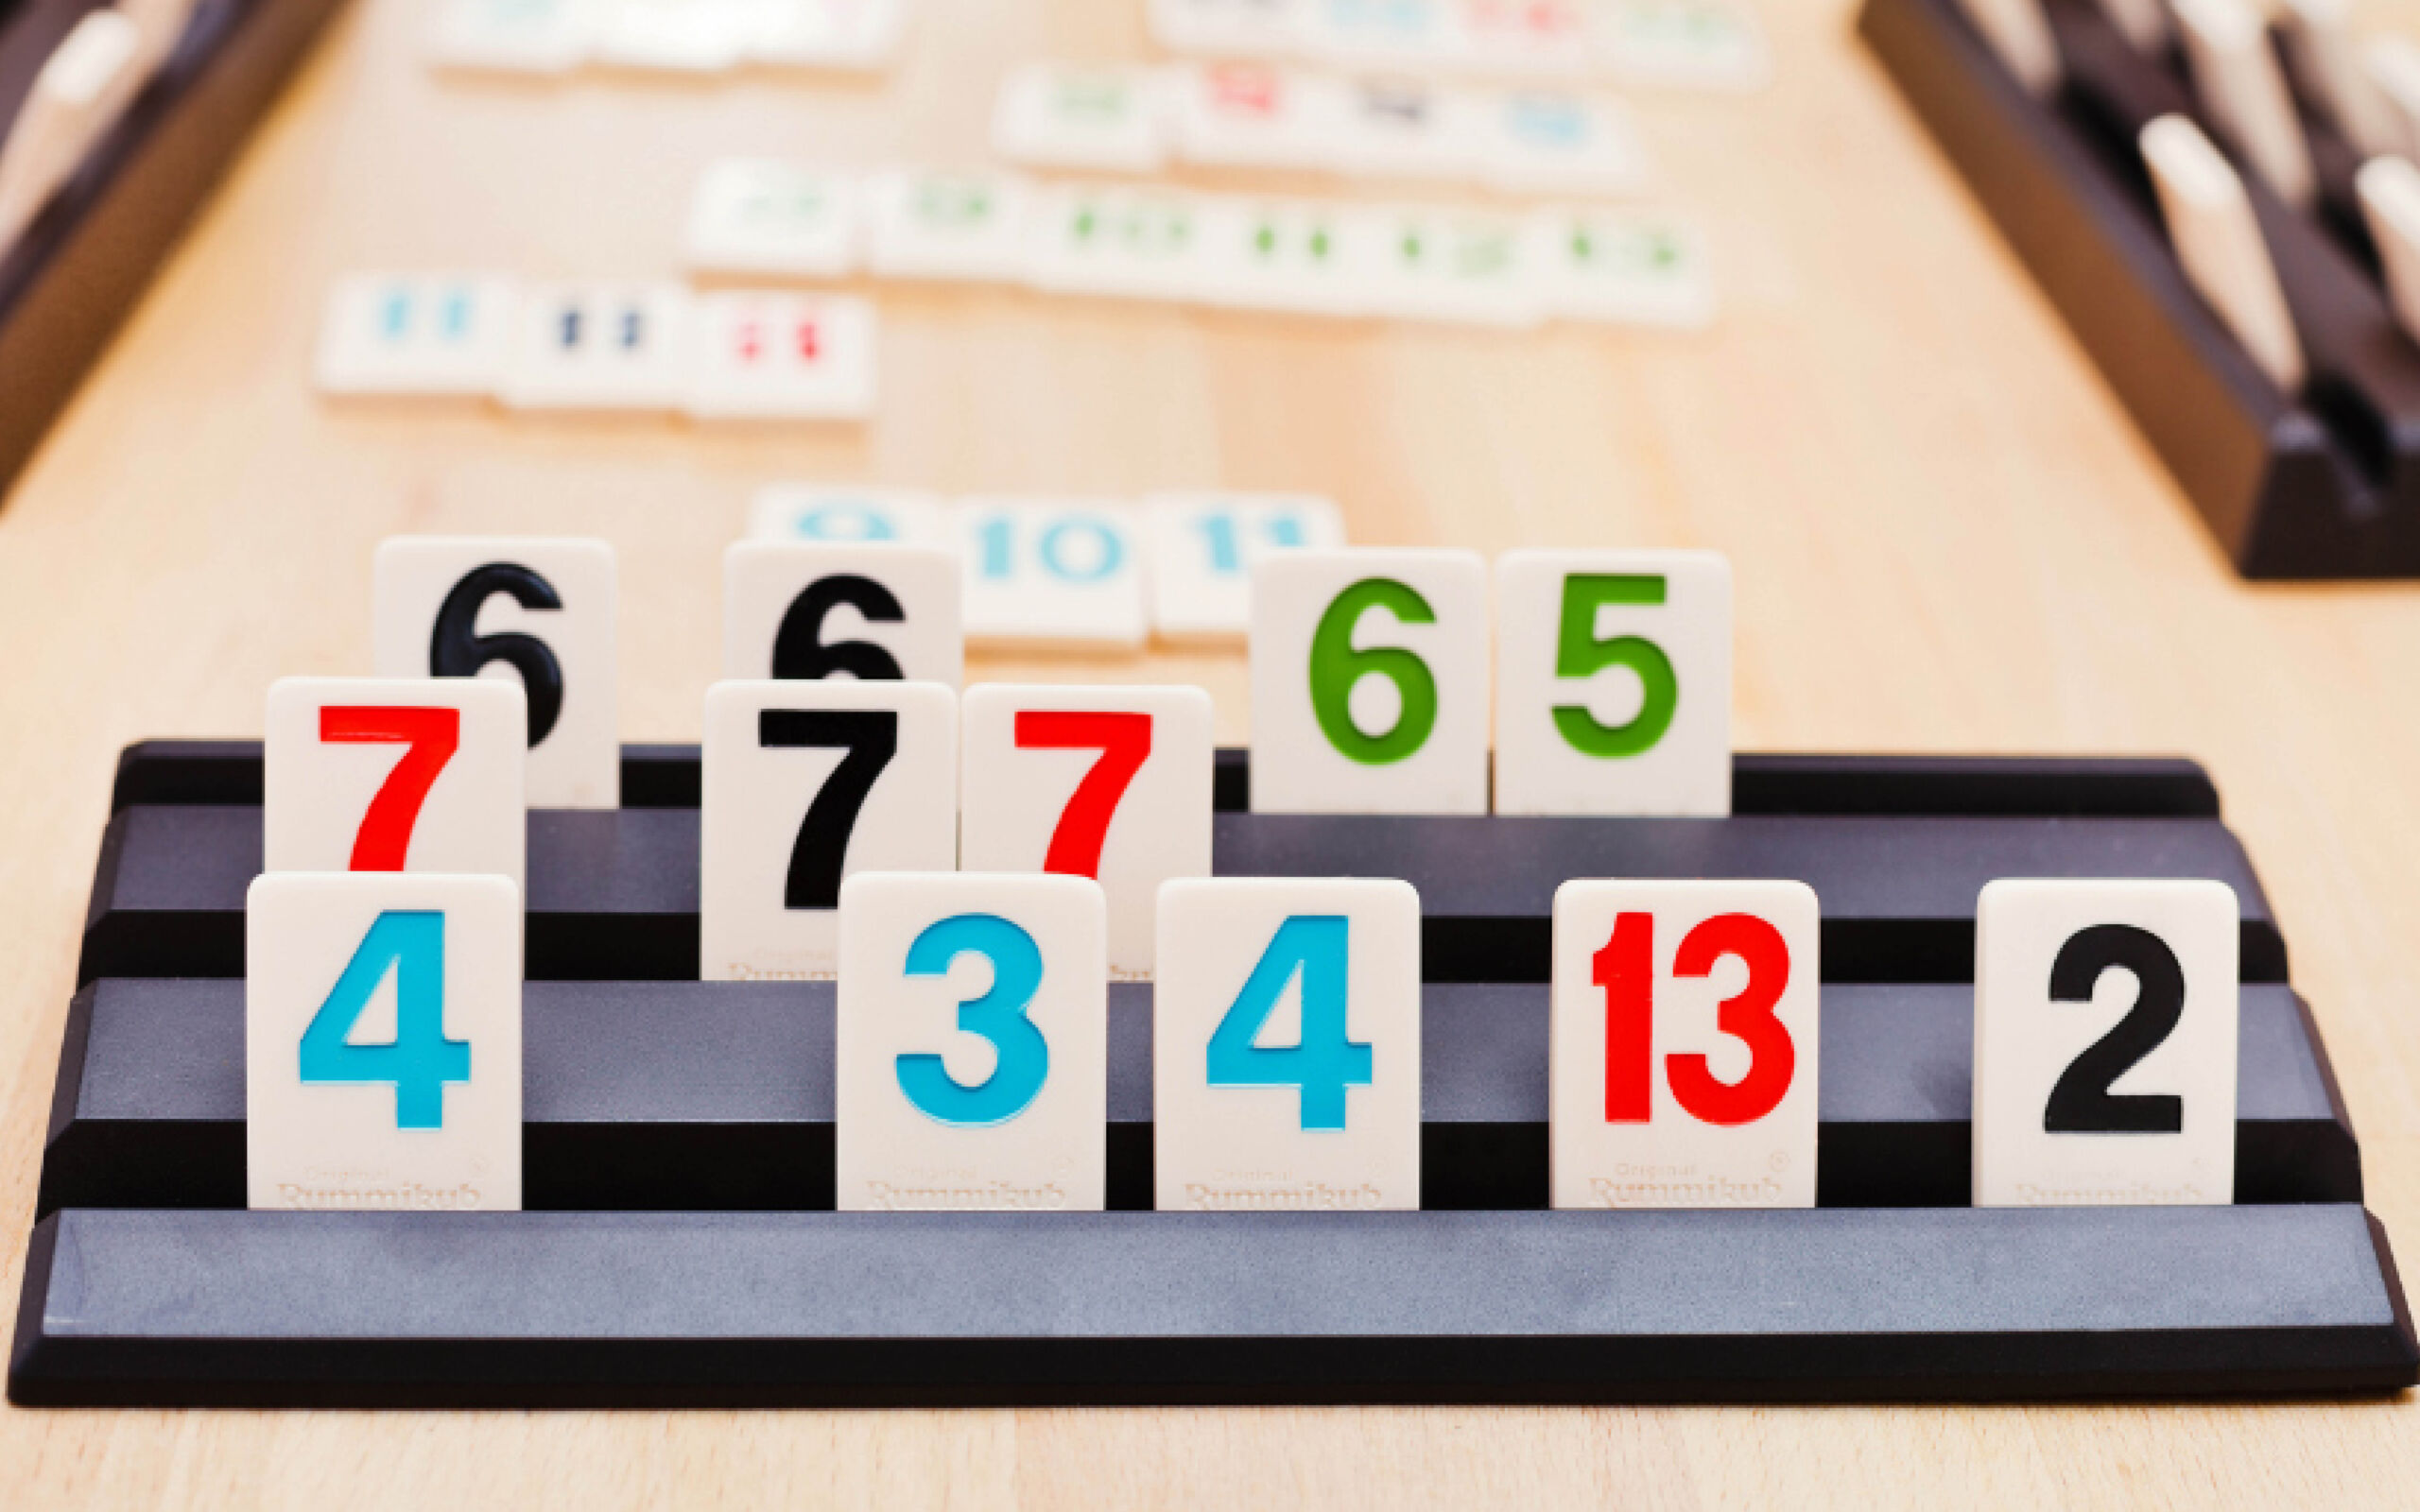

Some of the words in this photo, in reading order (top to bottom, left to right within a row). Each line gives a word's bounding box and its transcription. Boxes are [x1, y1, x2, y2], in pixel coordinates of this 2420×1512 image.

[769, 573, 906, 679] 6
[976, 512, 1125, 583] 10
[1195, 510, 1306, 574] 11
[429, 561, 564, 750] 6
[1307, 576, 1438, 765] 6
[1549, 573, 1679, 760] 5
[318, 706, 460, 871] 7
[758, 709, 899, 911] 7
[1014, 710, 1153, 879] 7
[298, 909, 472, 1128] 4
[894, 912, 1049, 1125] 3
[1205, 915, 1373, 1131] 4
[1591, 912, 1795, 1127] 13
[2042, 924, 2187, 1134] 2
[276, 1180, 481, 1210] Rummikub
[865, 1179, 1066, 1210] Rummikub
[1184, 1180, 1383, 1210] Rummikub
[1587, 1175, 1783, 1209] Rummikub
